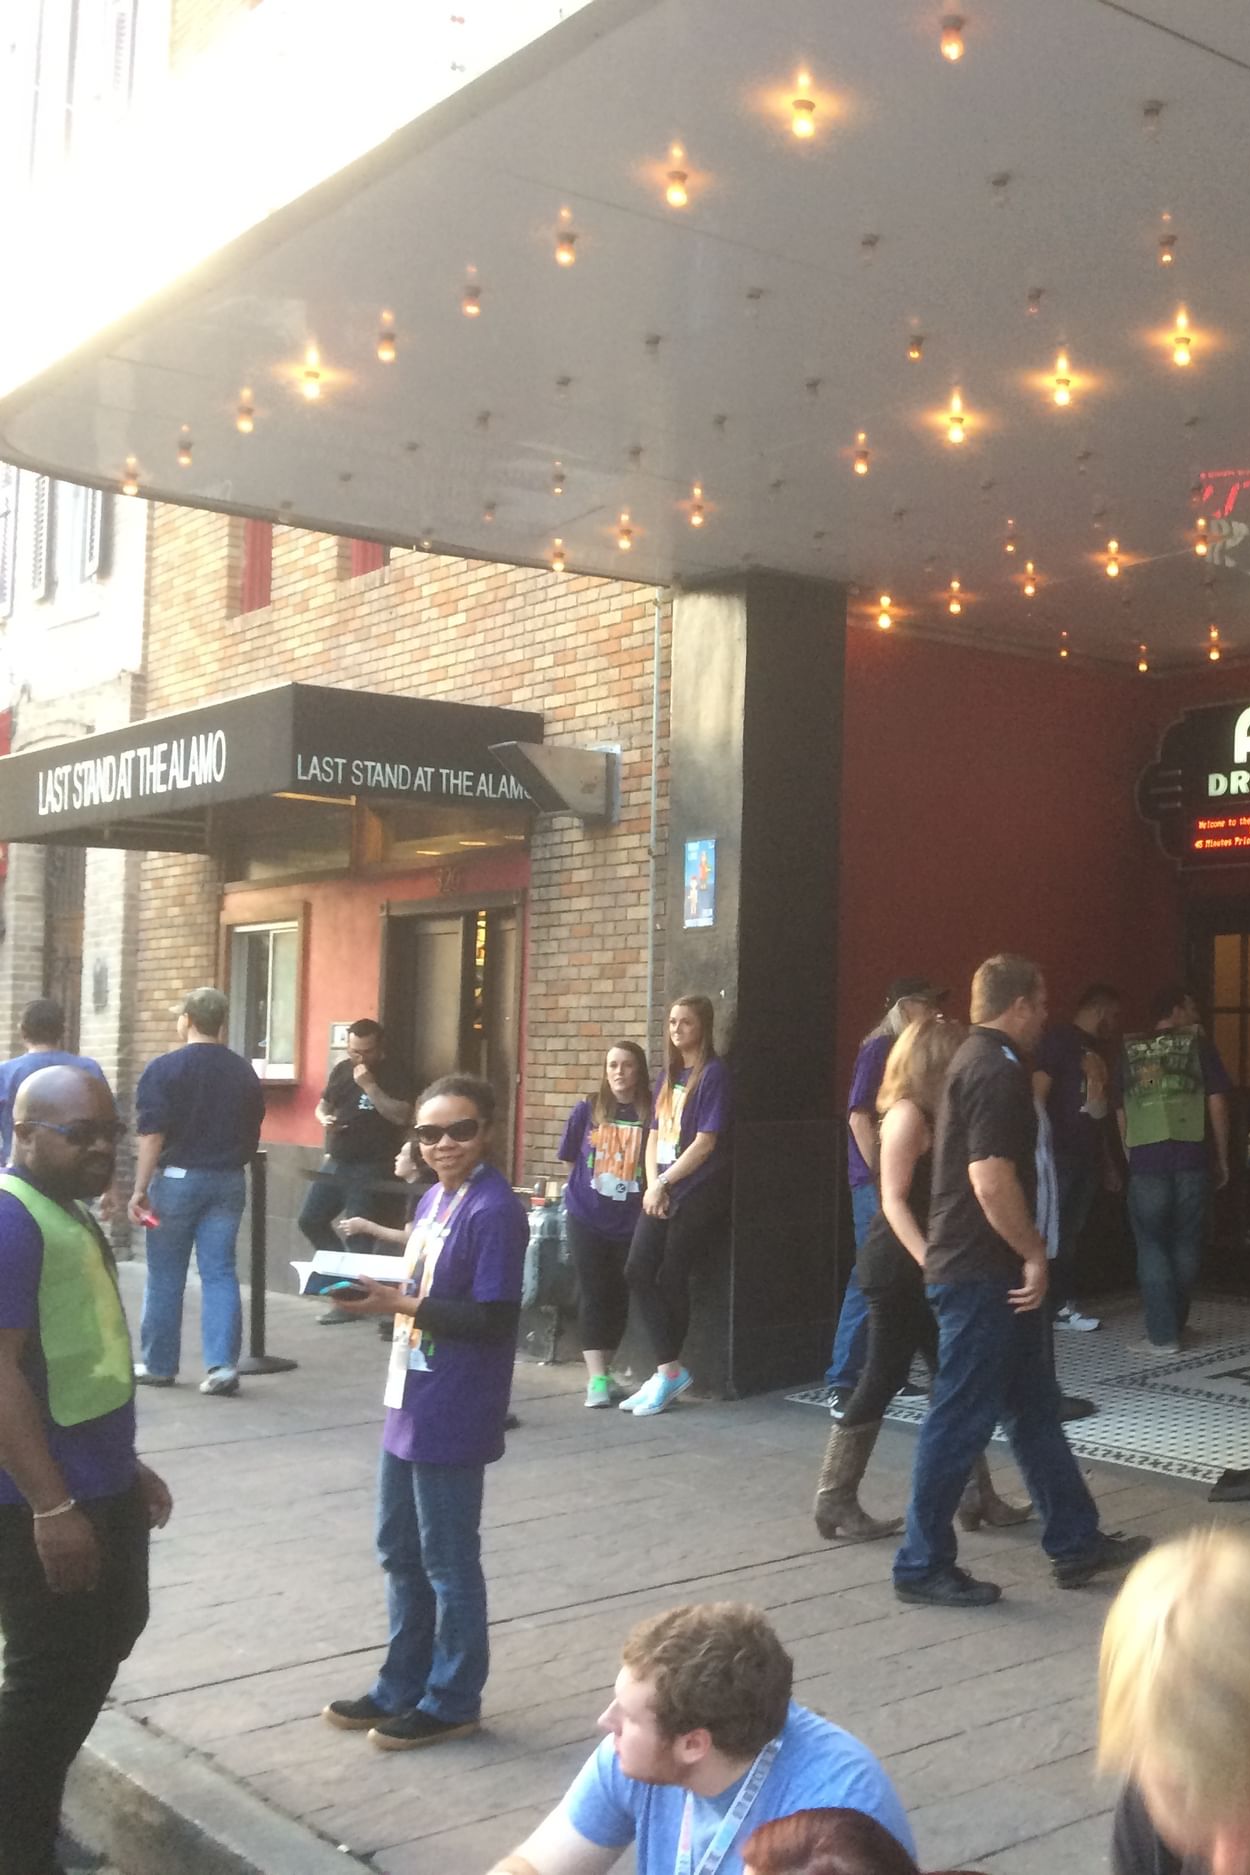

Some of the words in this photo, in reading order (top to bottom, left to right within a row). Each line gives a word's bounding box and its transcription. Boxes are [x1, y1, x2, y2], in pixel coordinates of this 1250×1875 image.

[38, 765, 72, 815] LAST
[72, 755, 116, 809] STAND
[116, 750, 135, 800] AT
[136, 742, 168, 796] THE
[168, 729, 226, 791] ALAMO
[297, 754, 347, 784] LAST
[351, 760, 411, 790] STAND
[413, 766, 435, 792] AT
[439, 768, 474, 796] THE
